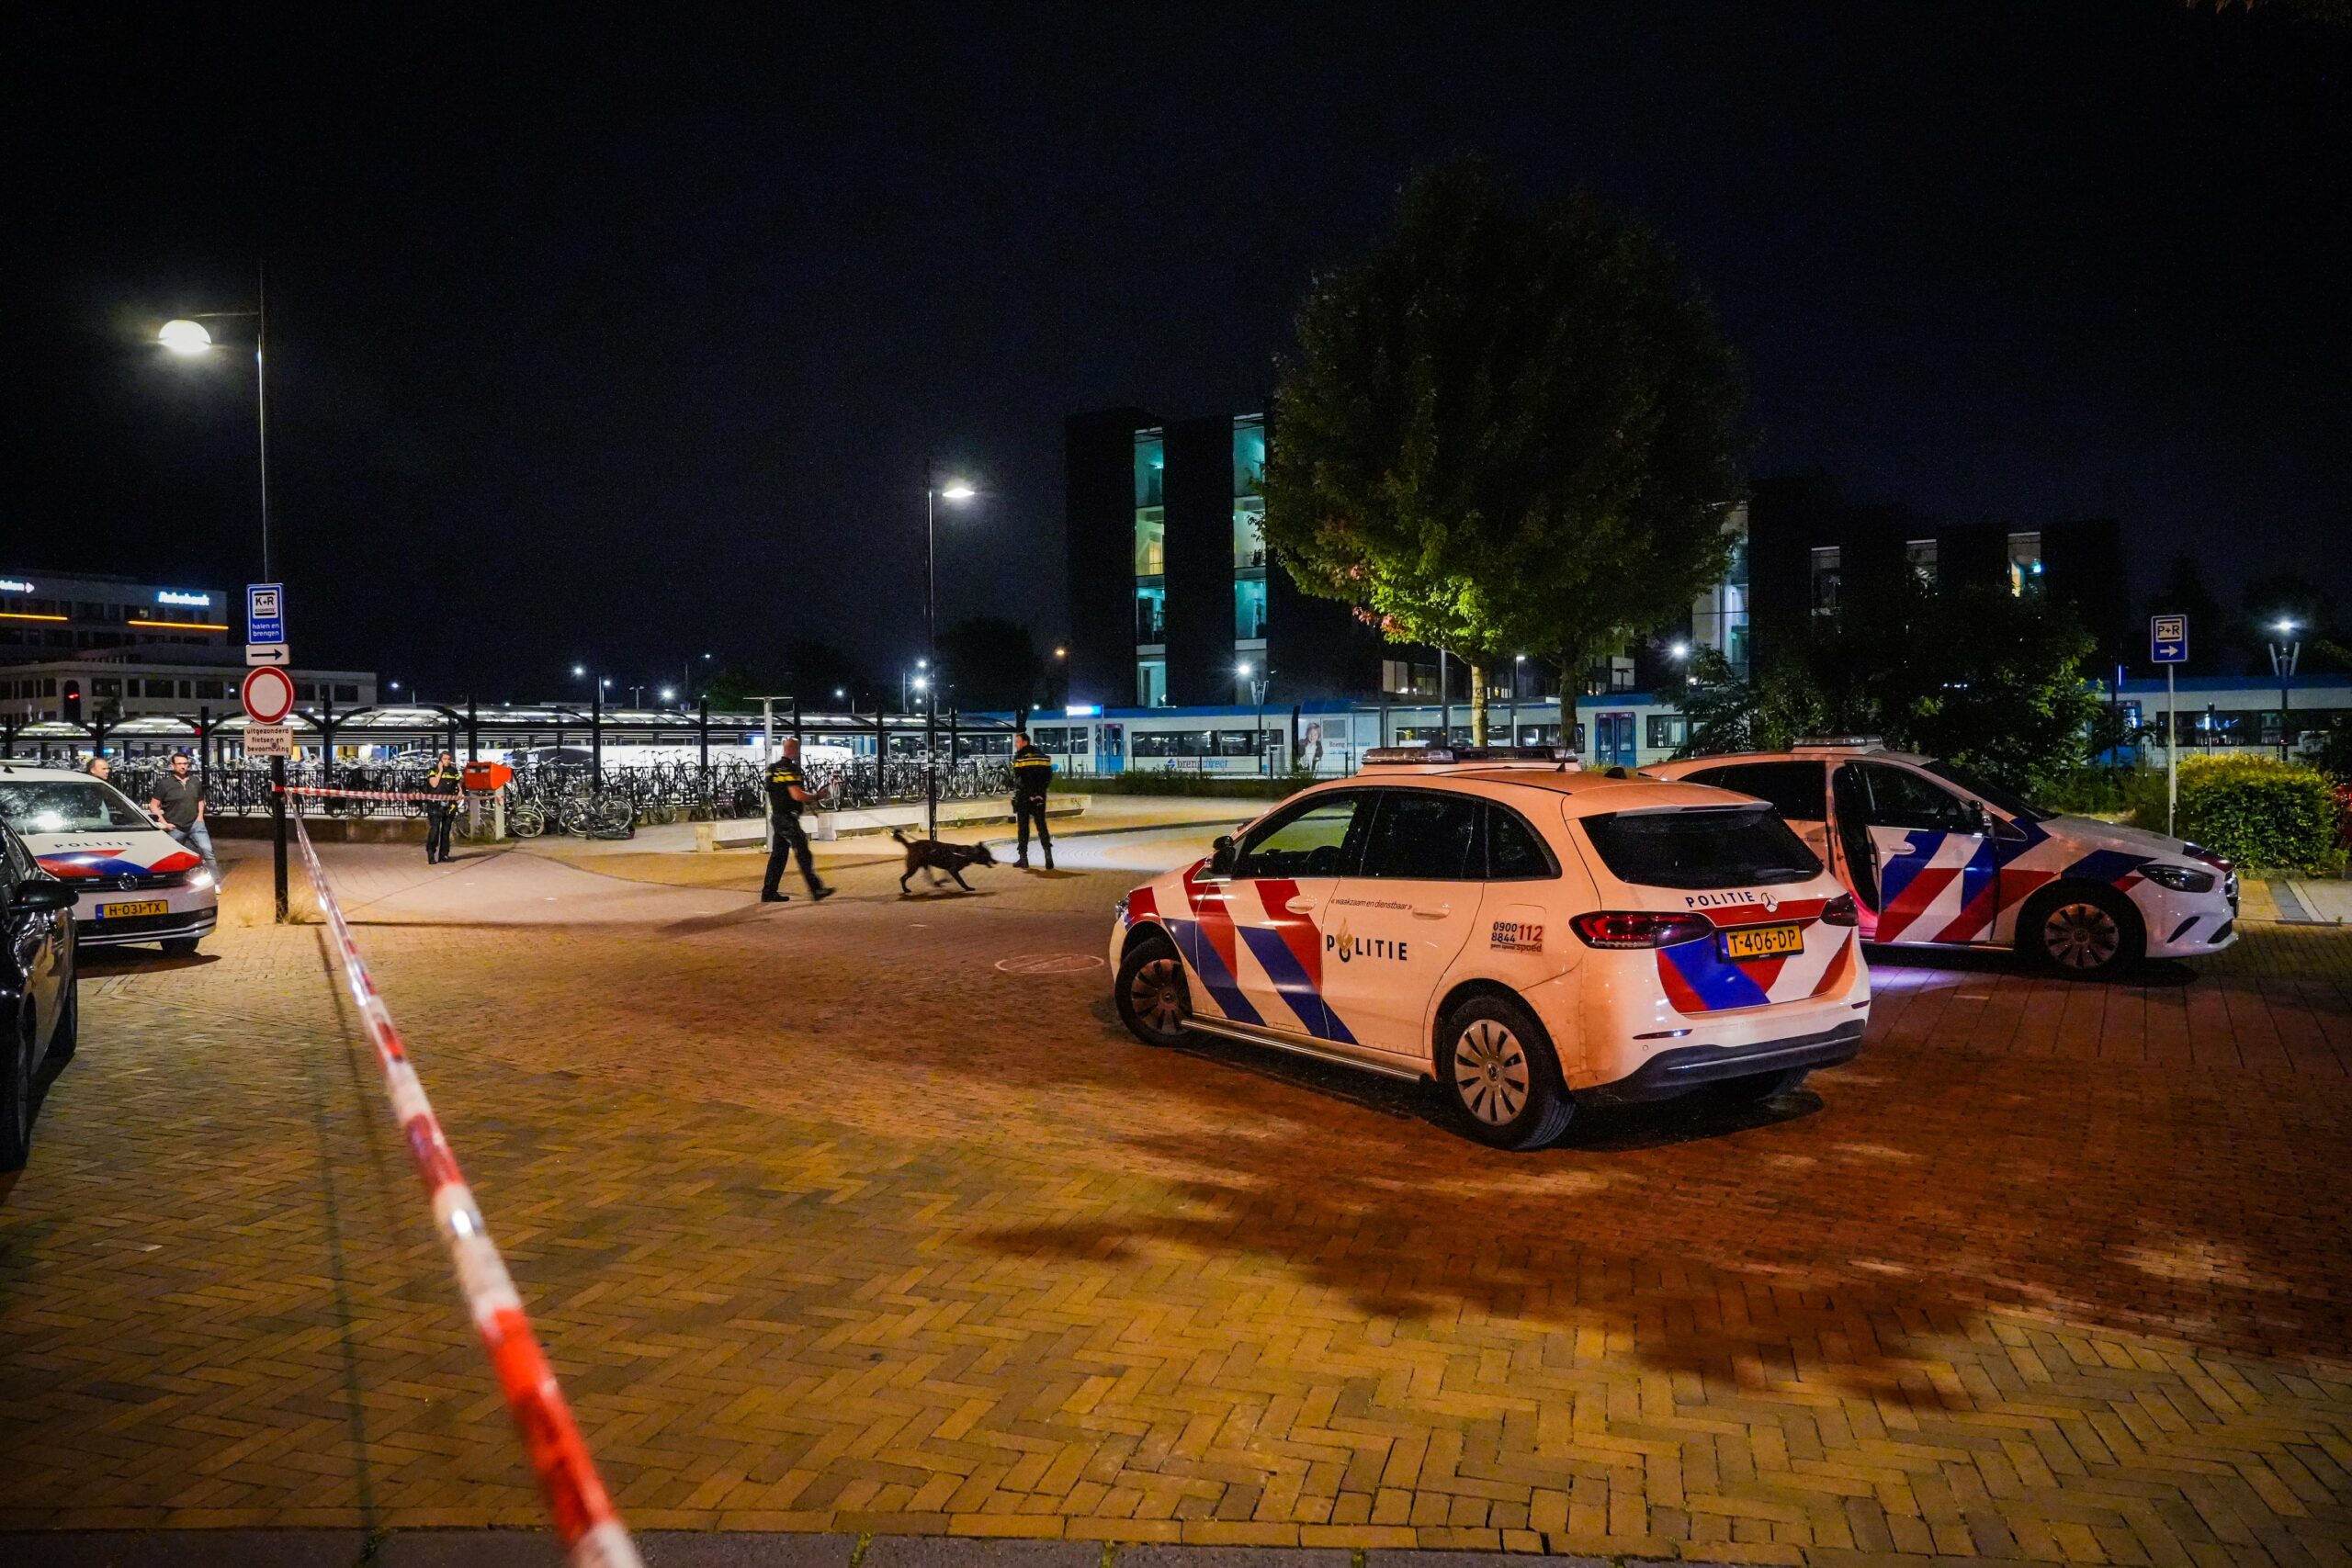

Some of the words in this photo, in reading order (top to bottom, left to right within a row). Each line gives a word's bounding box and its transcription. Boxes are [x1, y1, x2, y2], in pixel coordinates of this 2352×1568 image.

[2157, 625, 2180, 636] P+R
[1335, 897, 1366, 907] waakzaam
[1374, 900, 1408, 910] dienstbaar
[1685, 891, 1755, 908] POLITIE
[108, 902, 161, 916] H-031-TX
[1493, 921, 1518, 932] 0900
[1519, 924, 1544, 942] 112
[1491, 932, 1516, 942] 8844
[1730, 929, 1795, 953] T-406-DP
[1326, 934, 1408, 963] POLITIE
[1516, 943, 1543, 953] spoed
